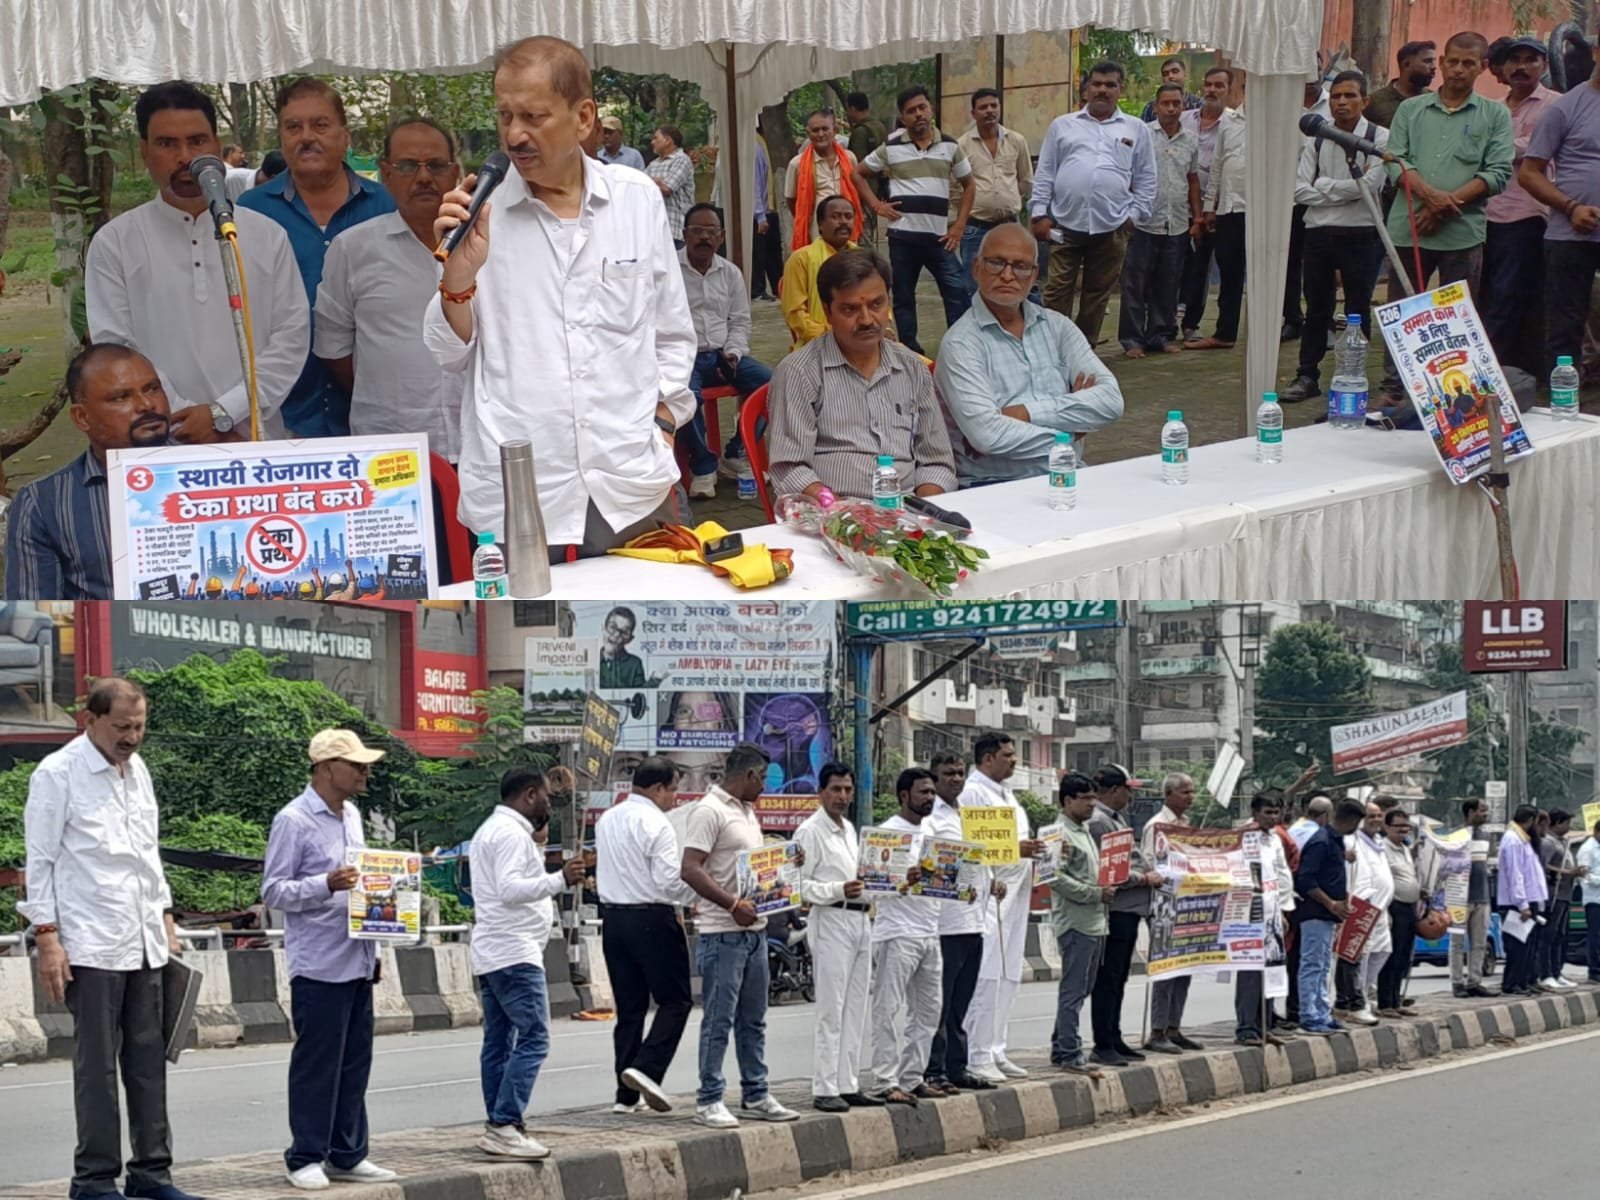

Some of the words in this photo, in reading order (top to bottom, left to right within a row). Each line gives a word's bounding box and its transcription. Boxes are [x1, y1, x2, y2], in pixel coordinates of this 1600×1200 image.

[1381, 306, 1400, 325] 206
[1402, 311, 1434, 336] सम्मान
[1433, 305, 1457, 324] काम
[1418, 328, 1431, 343] के
[1429, 323, 1451, 340] लिए
[1414, 339, 1446, 364] सम्मान
[1445, 333, 1470, 352] वेतन
[133, 470, 147, 488] 3
[178, 459, 247, 489] स्थायी
[252, 458, 333, 483] रोजगार
[337, 453, 360, 479] दो
[178, 493, 230, 519] ठेका
[235, 493, 279, 515] प्रथा
[283, 487, 316, 512] बंद
[321, 481, 364, 508] करो
[258, 526, 294, 545] ठेका
[260, 546, 294, 564] प्रथा
[647, 605, 677, 617] क्या
[737, 603, 779, 617] बच्चे
[785, 605, 809, 616] को
[858, 611, 906, 631] Call
[933, 600, 1105, 627] 9241724972
[642, 621, 666, 633] सिर
[671, 620, 688, 633] दर्द
[1482, 607, 1544, 634] LLB
[132, 608, 240, 645] WHOLESALER
[244, 623, 257, 646] &
[261, 625, 373, 660] MANUFACTURER
[536, 642, 576, 651] TRIVENI
[678, 658, 732, 671] AMBLYOPIA
[744, 658, 768, 671] LAZY
[772, 659, 791, 671] EYE
[424, 668, 466, 692] BALAJEE
[1344, 701, 1453, 740] SHAKUNTALAM
[661, 731, 677, 739] NO
[681, 731, 736, 740] SURGERY
[762, 815, 786, 825] NEW
[1000, 809, 1013, 820] का
